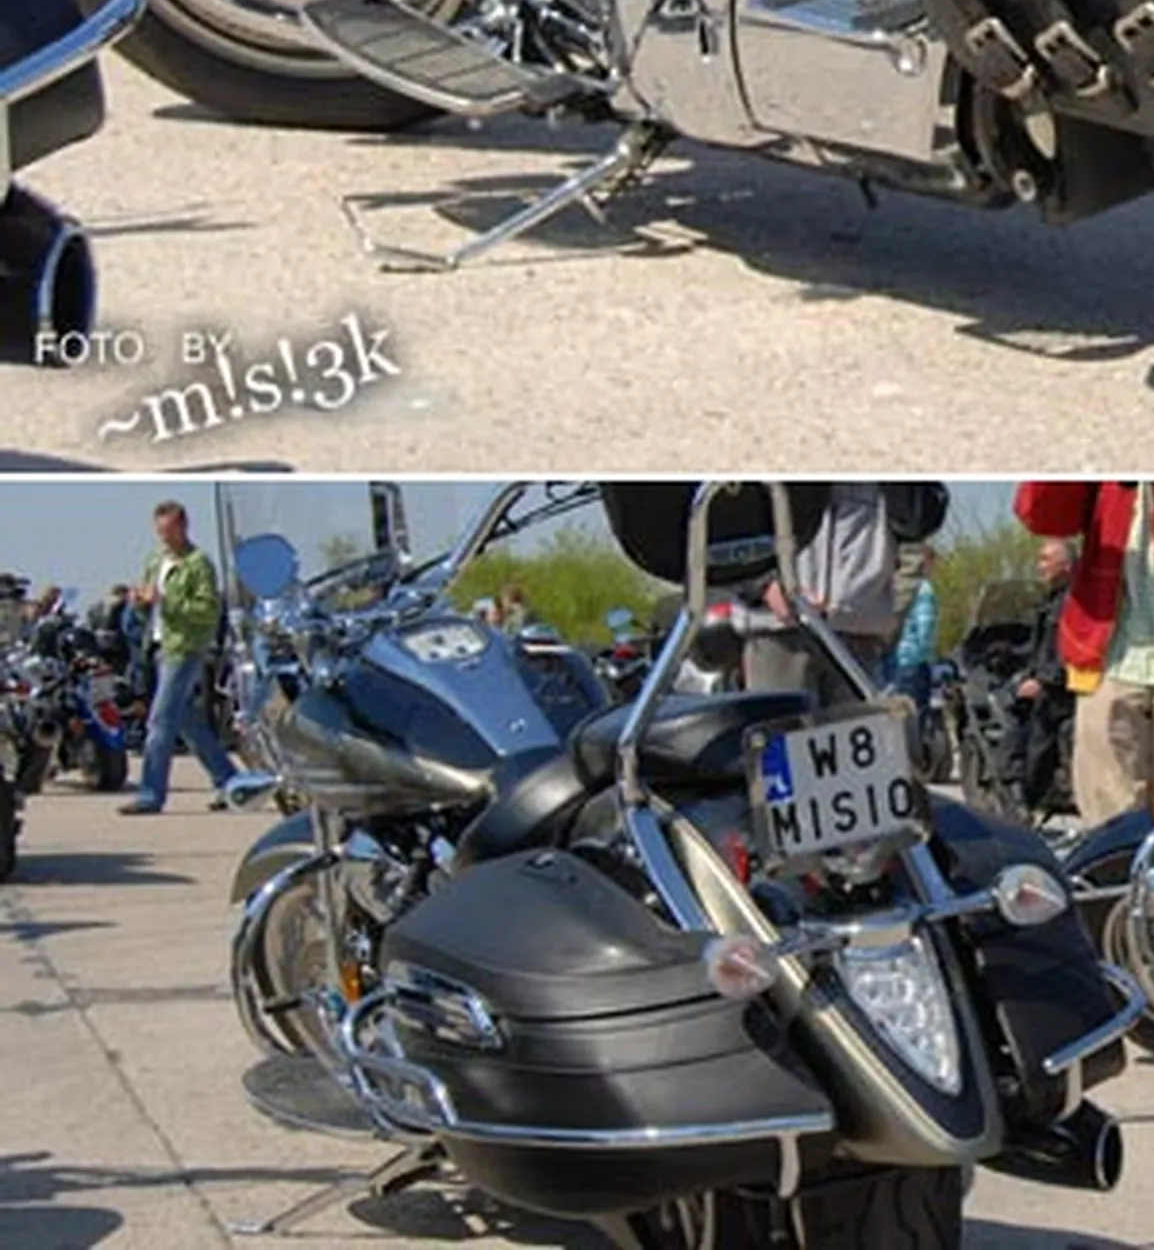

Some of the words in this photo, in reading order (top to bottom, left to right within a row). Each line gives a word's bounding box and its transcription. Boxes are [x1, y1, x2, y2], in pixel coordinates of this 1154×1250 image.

[807, 732, 838, 779] W
[850, 725, 876, 769] 8
[770, 777, 915, 847] MISIO
